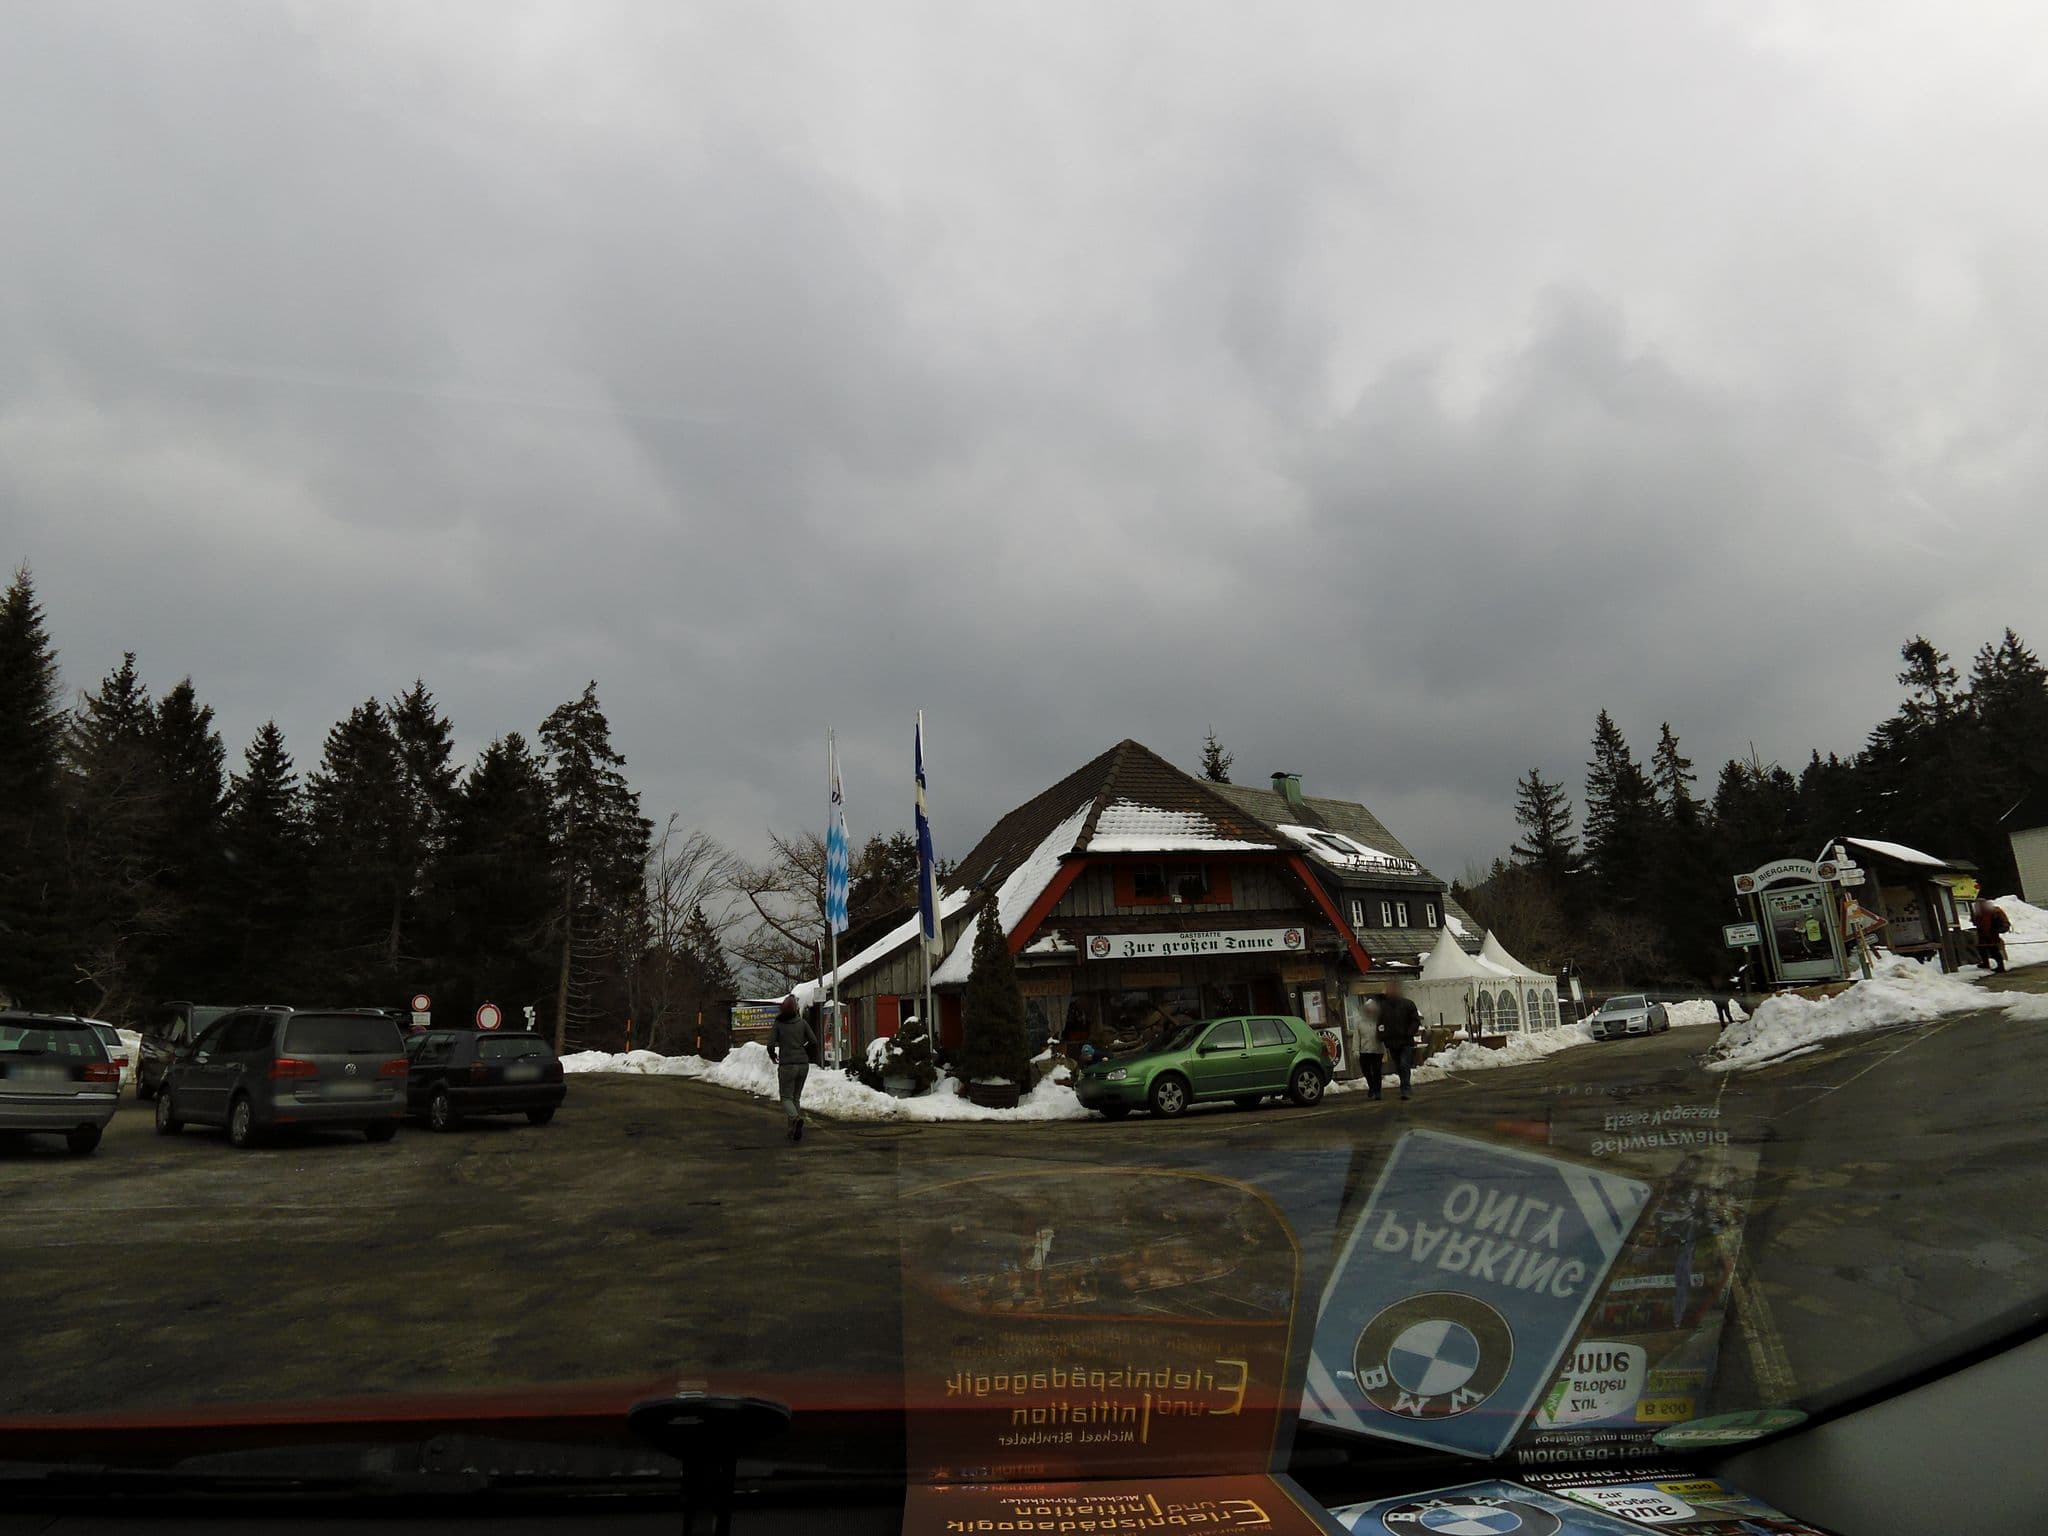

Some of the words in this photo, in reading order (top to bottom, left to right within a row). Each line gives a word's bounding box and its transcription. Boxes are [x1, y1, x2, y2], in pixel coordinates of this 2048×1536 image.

[1758, 864, 1812, 881] BIERGARTEN
[1179, 931, 1221, 939] GASTSTÄTTE
[1122, 940, 1155, 957] Zur
[1162, 938, 1218, 955] großen
[1225, 936, 1274, 949] Tanne
[1593, 1490, 1623, 1500] Zur
[1604, 1496, 1664, 1508] großen
[946, 1500, 1272, 1533] Erlebnispädagogik
[1387, 1495, 1510, 1523] BMW
